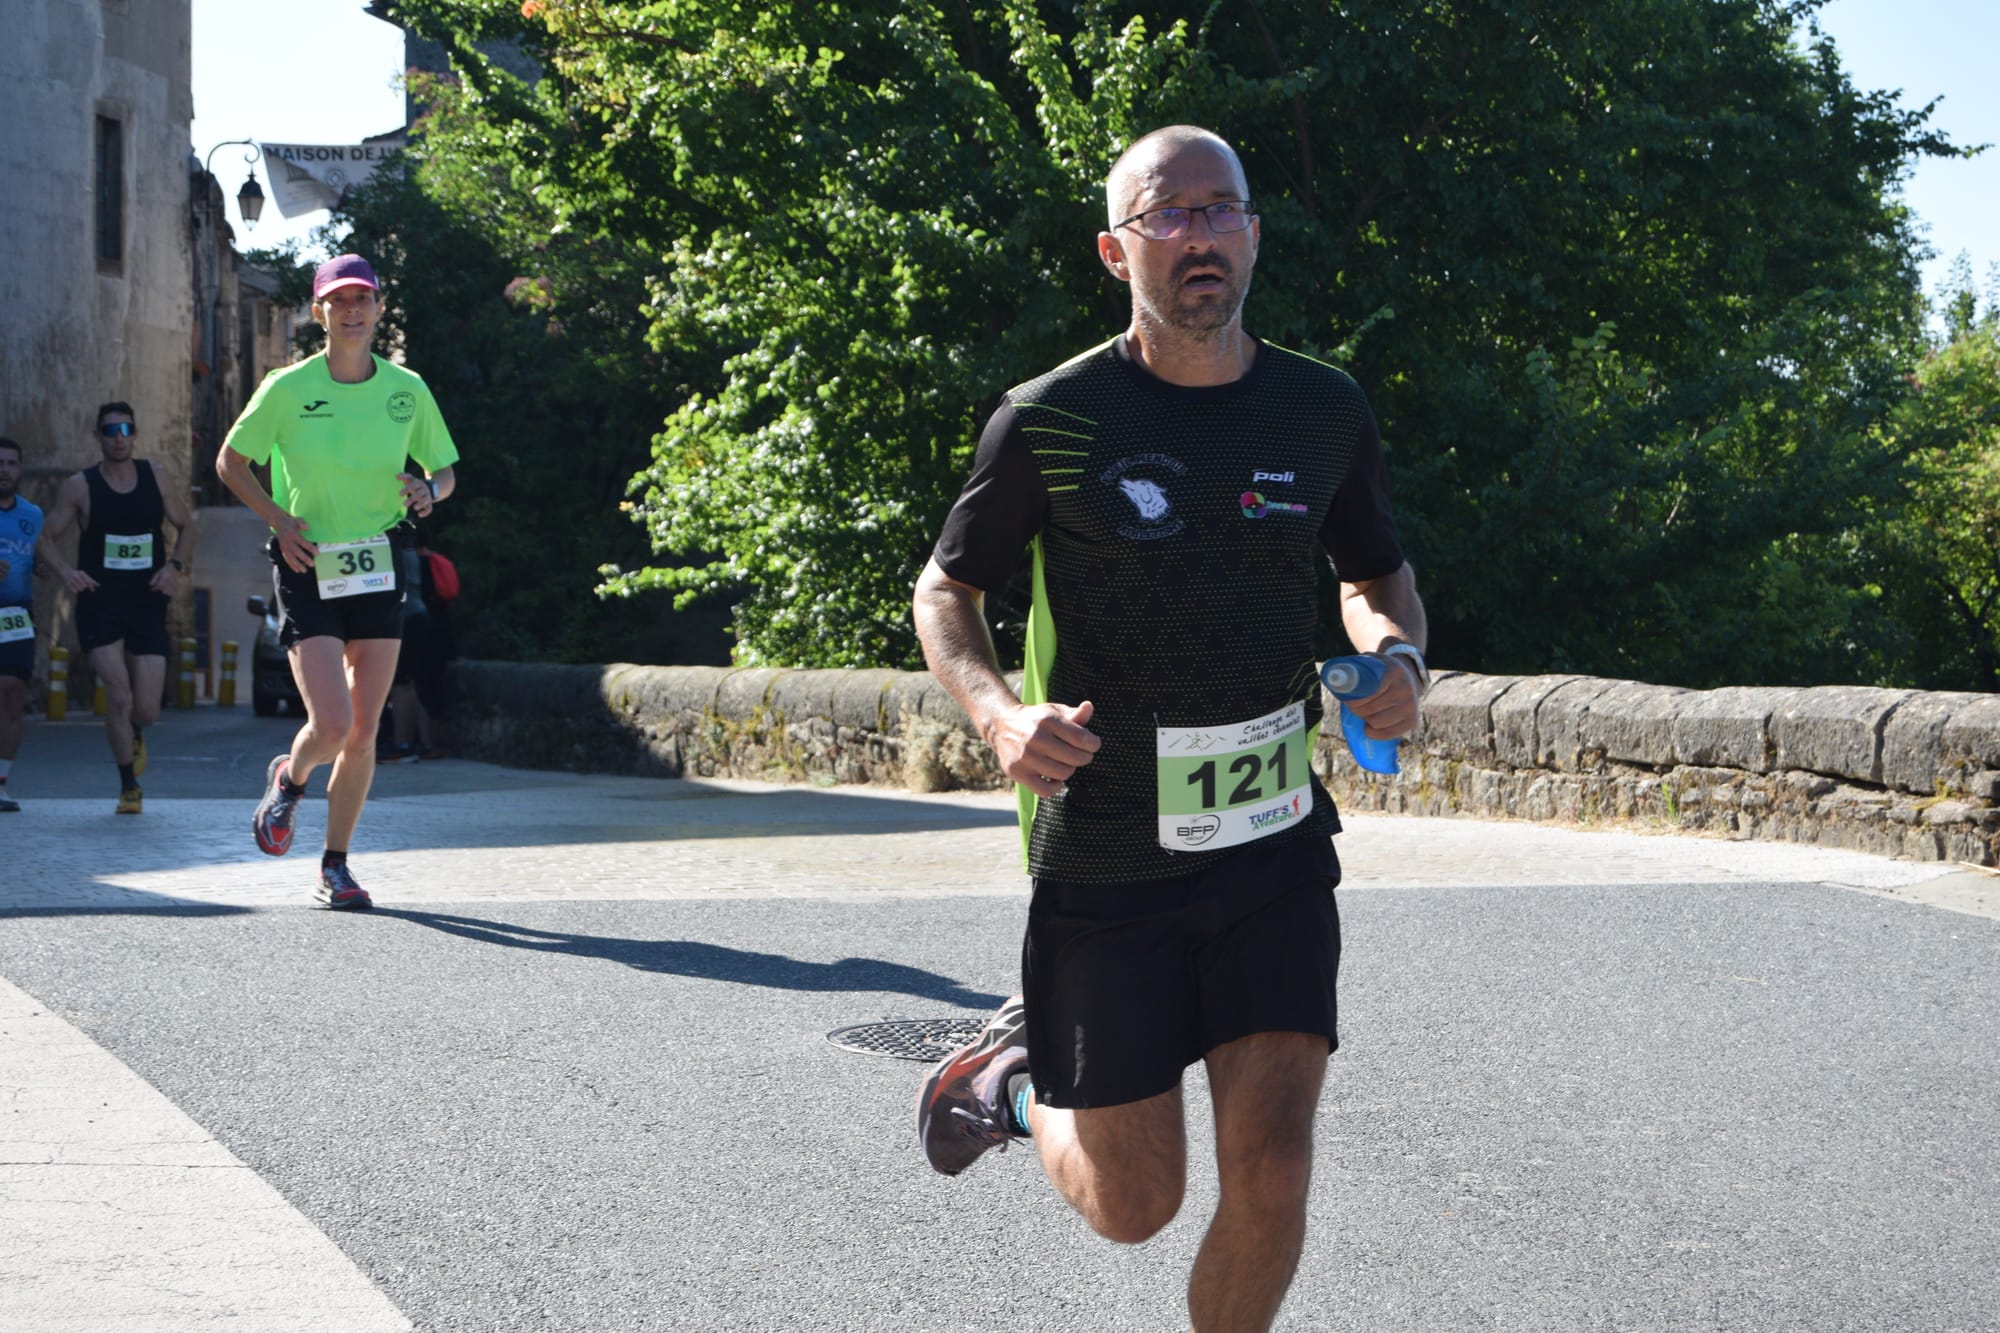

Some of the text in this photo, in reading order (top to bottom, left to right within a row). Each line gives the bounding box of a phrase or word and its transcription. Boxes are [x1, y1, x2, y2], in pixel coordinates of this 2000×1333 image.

[351, 147, 374, 161] DE
[1252, 471, 1295, 483] poli
[118, 544, 141, 559] 82
[337, 549, 375, 575] 36
[0, 615, 25, 631] 38
[1243, 715, 1283, 735] Challenge
[1187, 742, 1287, 809] 121
[1249, 804, 1289, 825] TUFF'S
[1177, 824, 1215, 837] BFP
